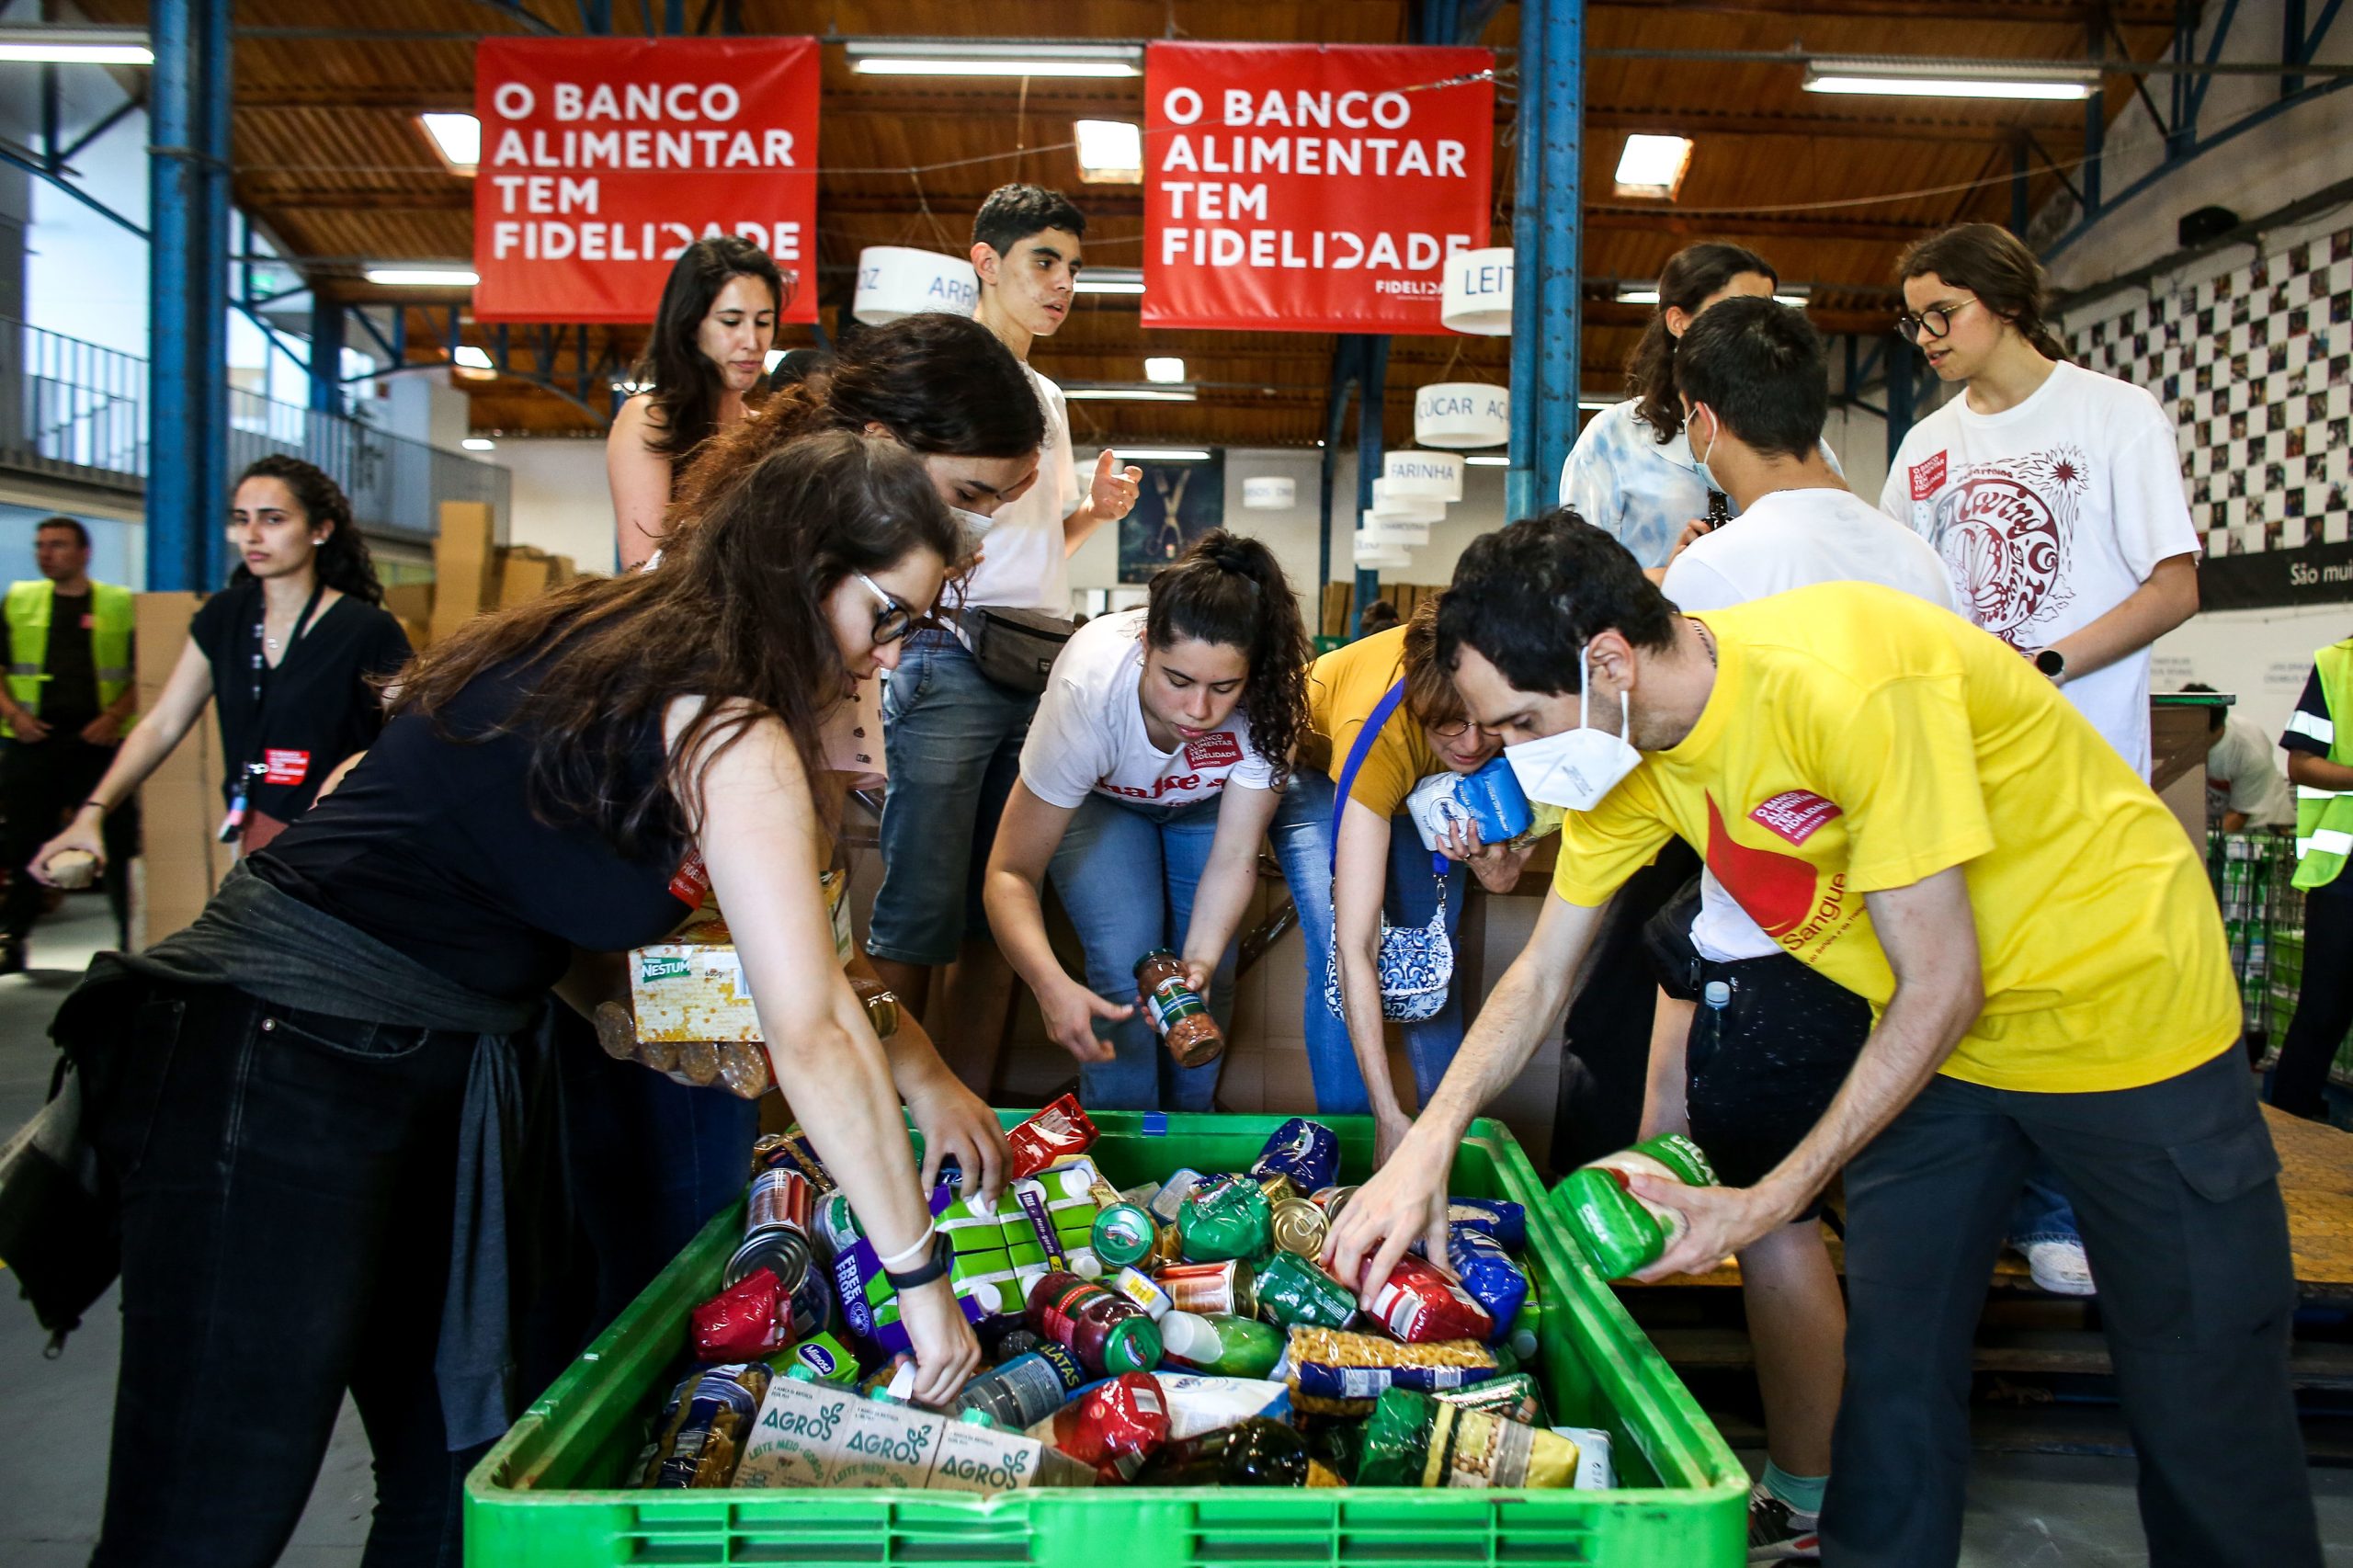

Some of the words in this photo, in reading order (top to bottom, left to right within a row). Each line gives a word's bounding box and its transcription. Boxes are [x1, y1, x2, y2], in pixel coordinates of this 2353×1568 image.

[494, 83, 535, 120] O
[554, 83, 740, 122] BANCO
[1163, 87, 1204, 126] O
[1224, 89, 1410, 131] BANCO
[494, 130, 795, 168] ALIMENTAR
[1161, 135, 1467, 178] ALIMENTAR
[493, 176, 597, 215] TEM
[1161, 182, 1268, 221] TEM
[928, 277, 980, 305] ARR
[1391, 463, 1454, 481] FARINHA
[2290, 562, 2319, 585] São
[1191, 751, 1237, 762] FIDELIDADE
[1755, 809, 1768, 817] O
[1763, 792, 1800, 810] BANCO
[1766, 794, 1818, 826] ALIMENTAR
[1774, 810, 1796, 827] TEM
[1780, 801, 1835, 835] FIDELIDADE
[1782, 873, 1846, 951] Sangue
[642, 960, 691, 978] NESTUM
[835, 1263, 854, 1306] FROM
[844, 1254, 862, 1300] FREE
[804, 1345, 833, 1372] Mimosa
[761, 1403, 845, 1442] AGROS
[748, 1440, 774, 1461] LEITE
[846, 1425, 933, 1465] AGROS
[939, 1449, 1029, 1491] AGROS
